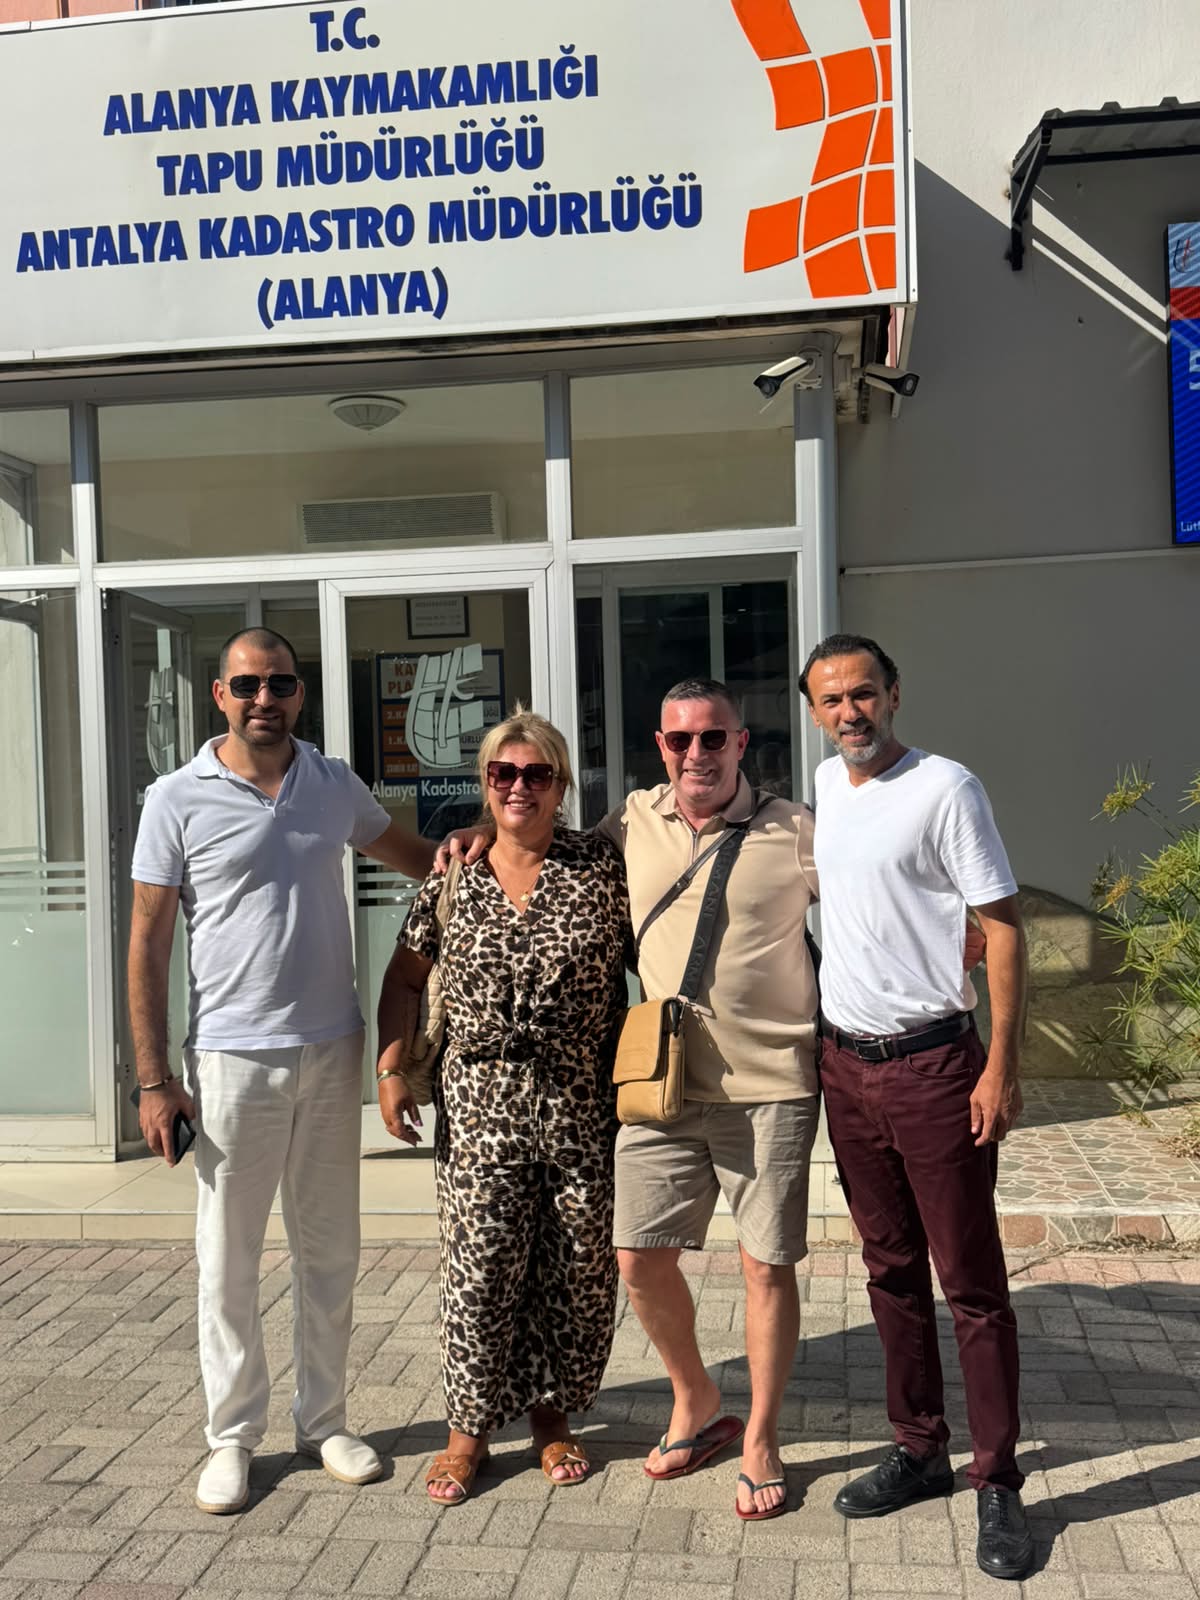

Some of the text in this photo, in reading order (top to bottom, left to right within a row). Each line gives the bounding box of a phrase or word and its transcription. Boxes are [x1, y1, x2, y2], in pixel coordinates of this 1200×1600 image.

[309, 6, 381, 53] T.C.
[103, 43, 599, 137] ALANYA KAYMAKAMLIĞI
[156, 114, 545, 197] TAPU MÜDÜRLÜĞÜ
[16, 171, 703, 274] ANTALYA KADASTRO MÜDÜRLÜĞÜ
[257, 266, 449, 330] (ALANYA)
[371, 777, 481, 802] Alanya Kadastro
